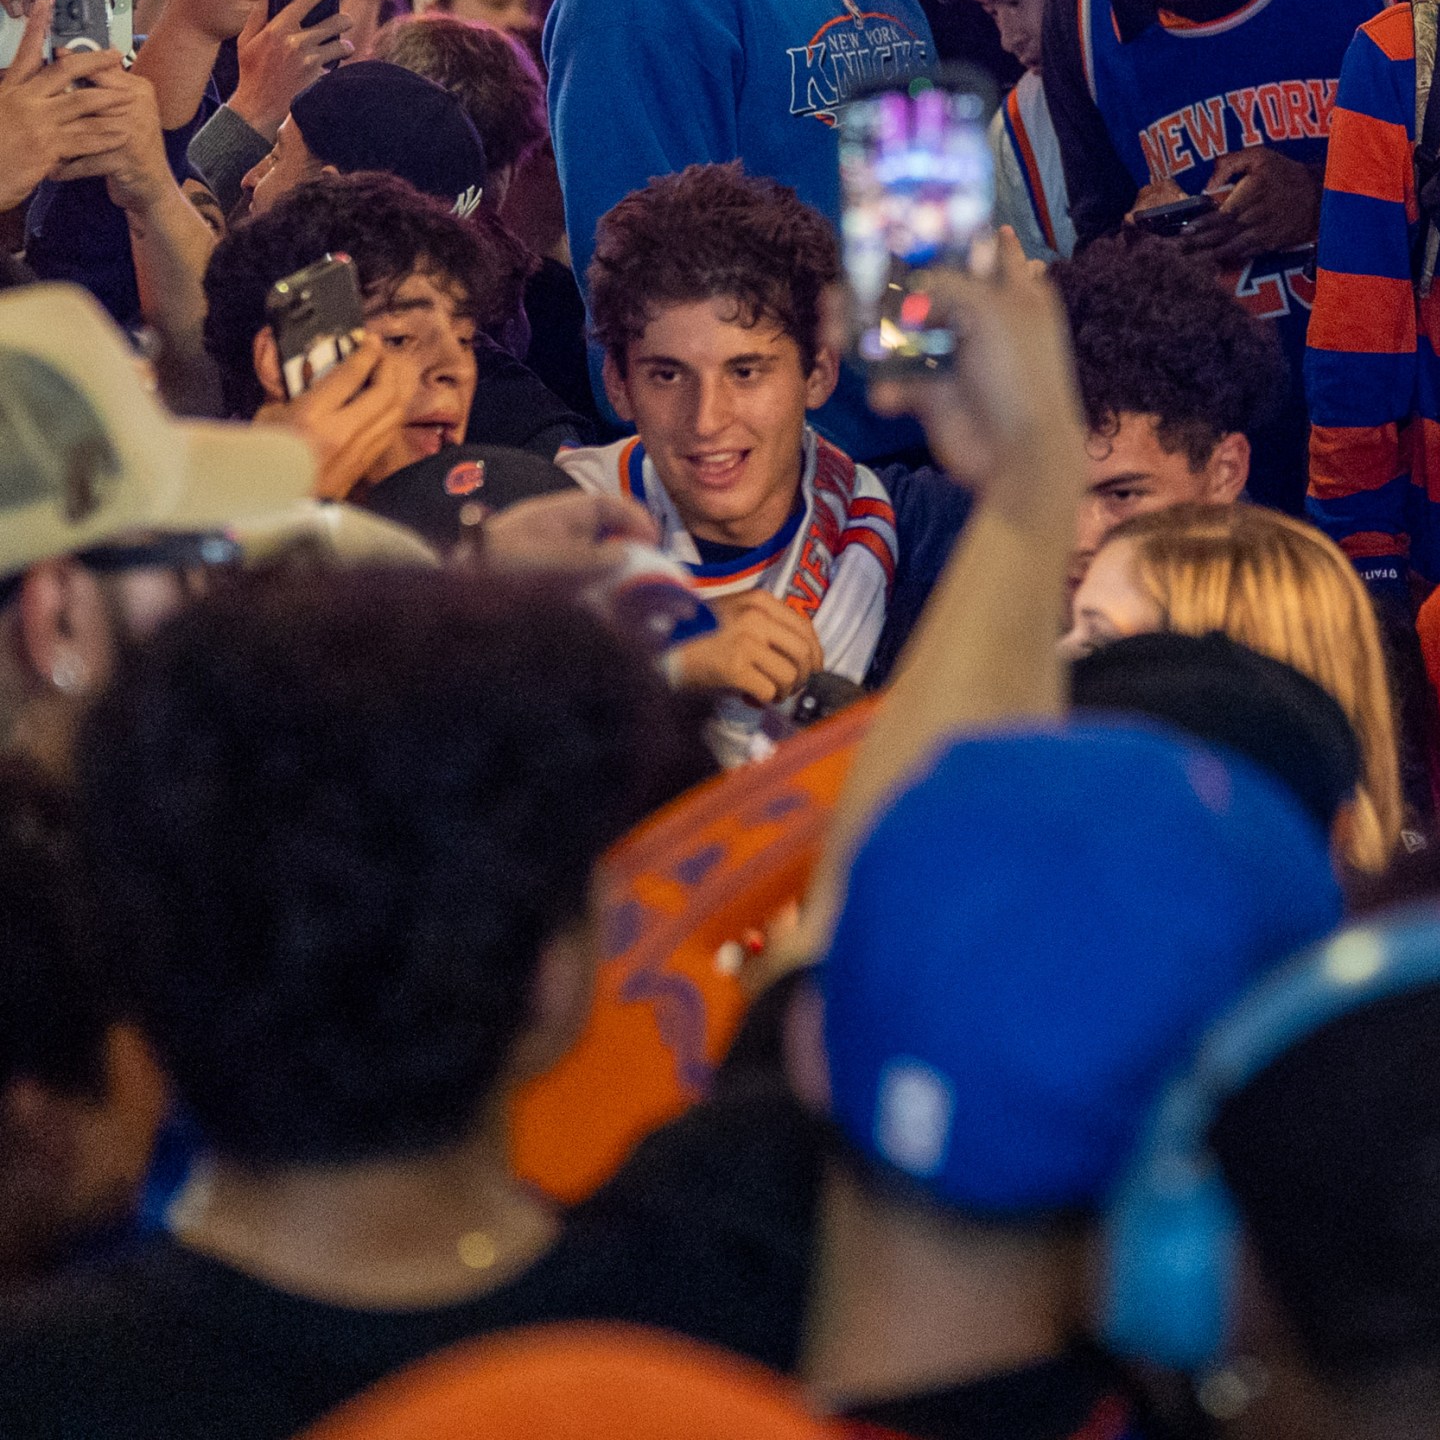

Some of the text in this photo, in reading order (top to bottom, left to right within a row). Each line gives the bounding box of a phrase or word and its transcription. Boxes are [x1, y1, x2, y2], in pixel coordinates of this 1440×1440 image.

[827, 24, 900, 52] NEW YORK
[1138, 78, 1340, 185] NEW YORK
